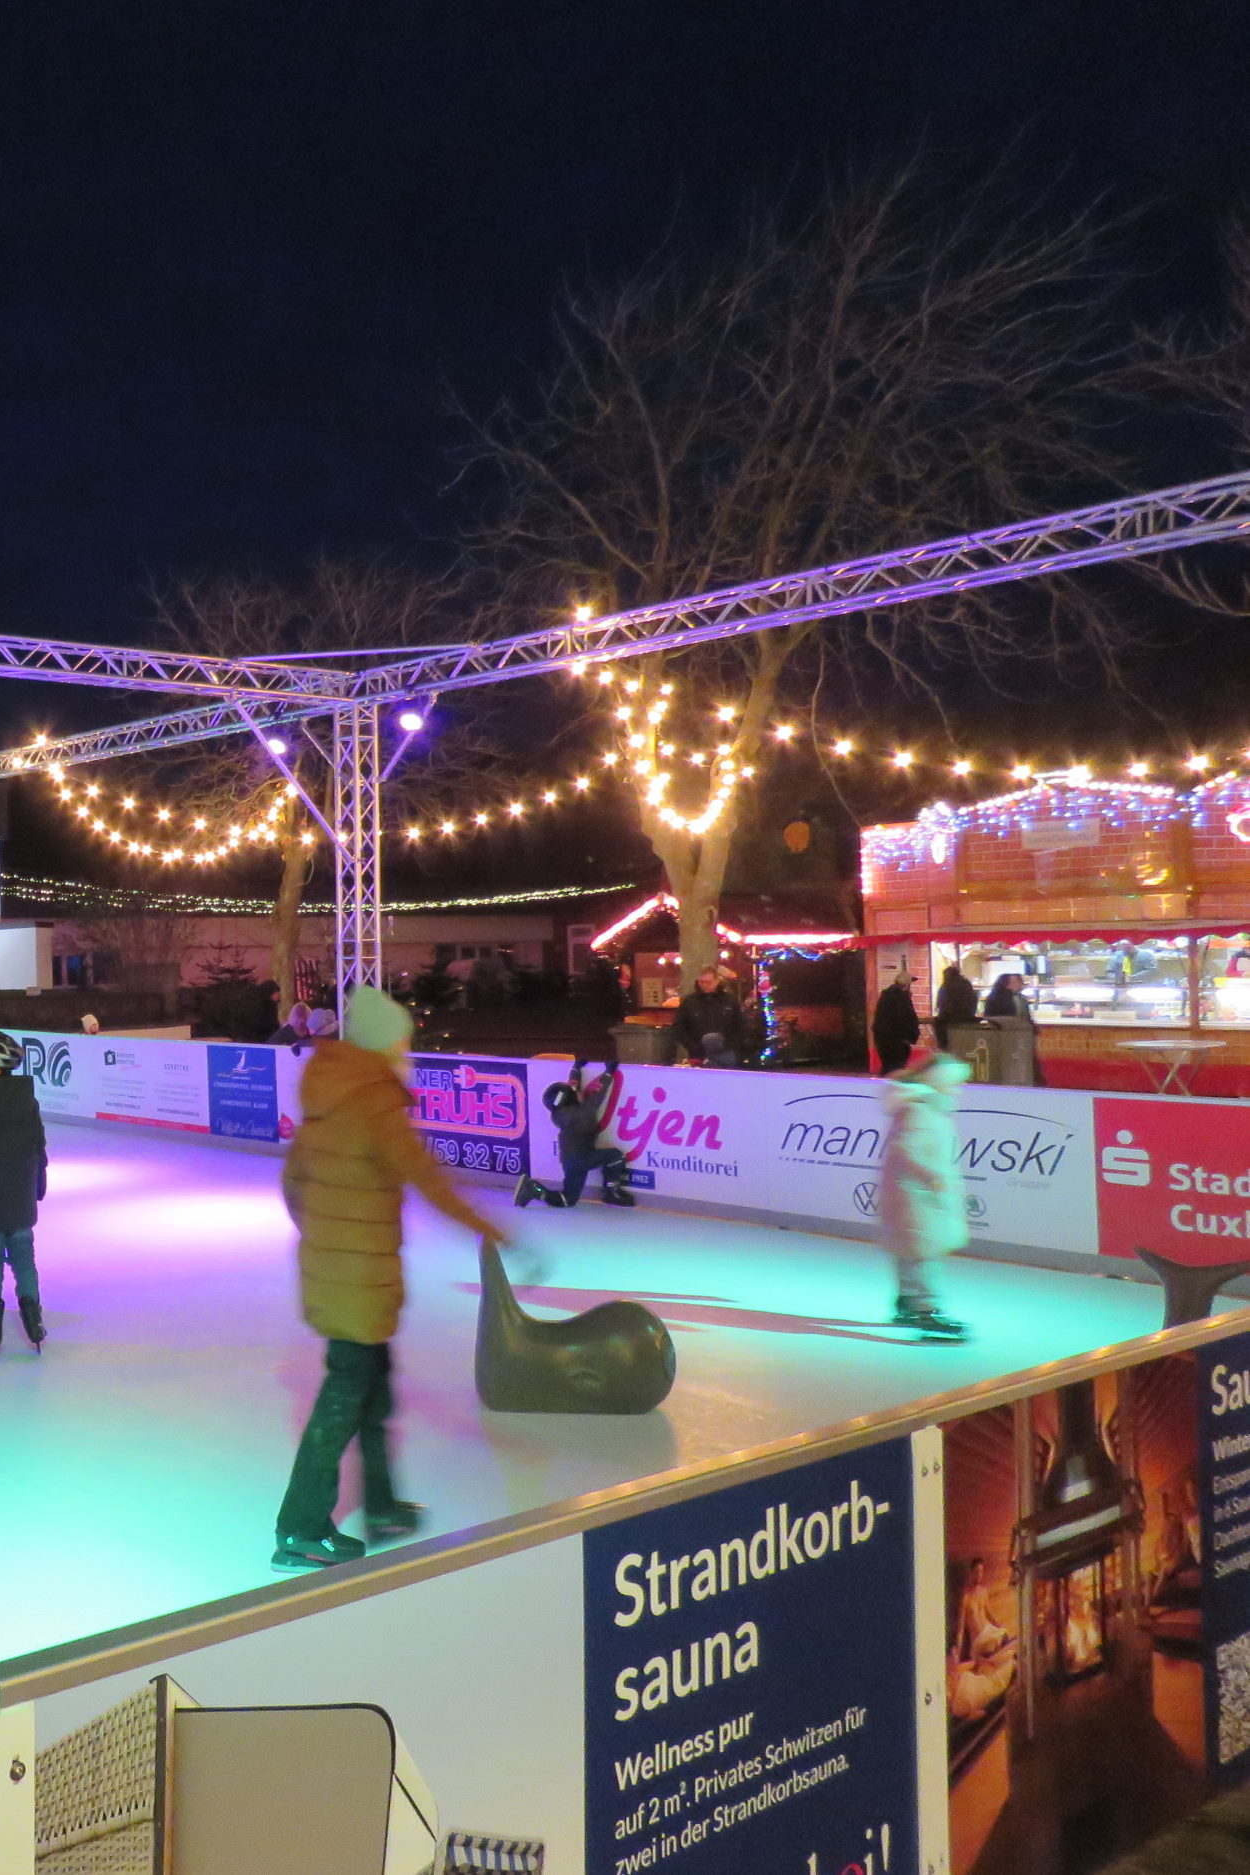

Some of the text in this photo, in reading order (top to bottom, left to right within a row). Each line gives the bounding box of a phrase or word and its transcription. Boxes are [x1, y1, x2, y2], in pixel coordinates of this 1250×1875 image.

[410, 1087, 515, 1128] TRUHS
[413, 1068, 453, 1090] NER
[462, 1141, 491, 1170] 32
[493, 1144, 522, 1174] 75
[646, 1150, 740, 1178] Konditorei
[780, 1122, 1075, 1177] manwski
[613, 1479, 892, 1629] Strandkorb-
[613, 1620, 760, 1723] sauna
[614, 1709, 755, 1793] Wellness pur
[614, 1802, 647, 1841] auf
[648, 1797, 661, 1825] 2
[693, 1752, 763, 1805] Privates
[764, 1719, 844, 1769] Schwitzen
[844, 1704, 869, 1734] für
[614, 1749, 851, 1875] zwei in der Strandkorbsauna.
